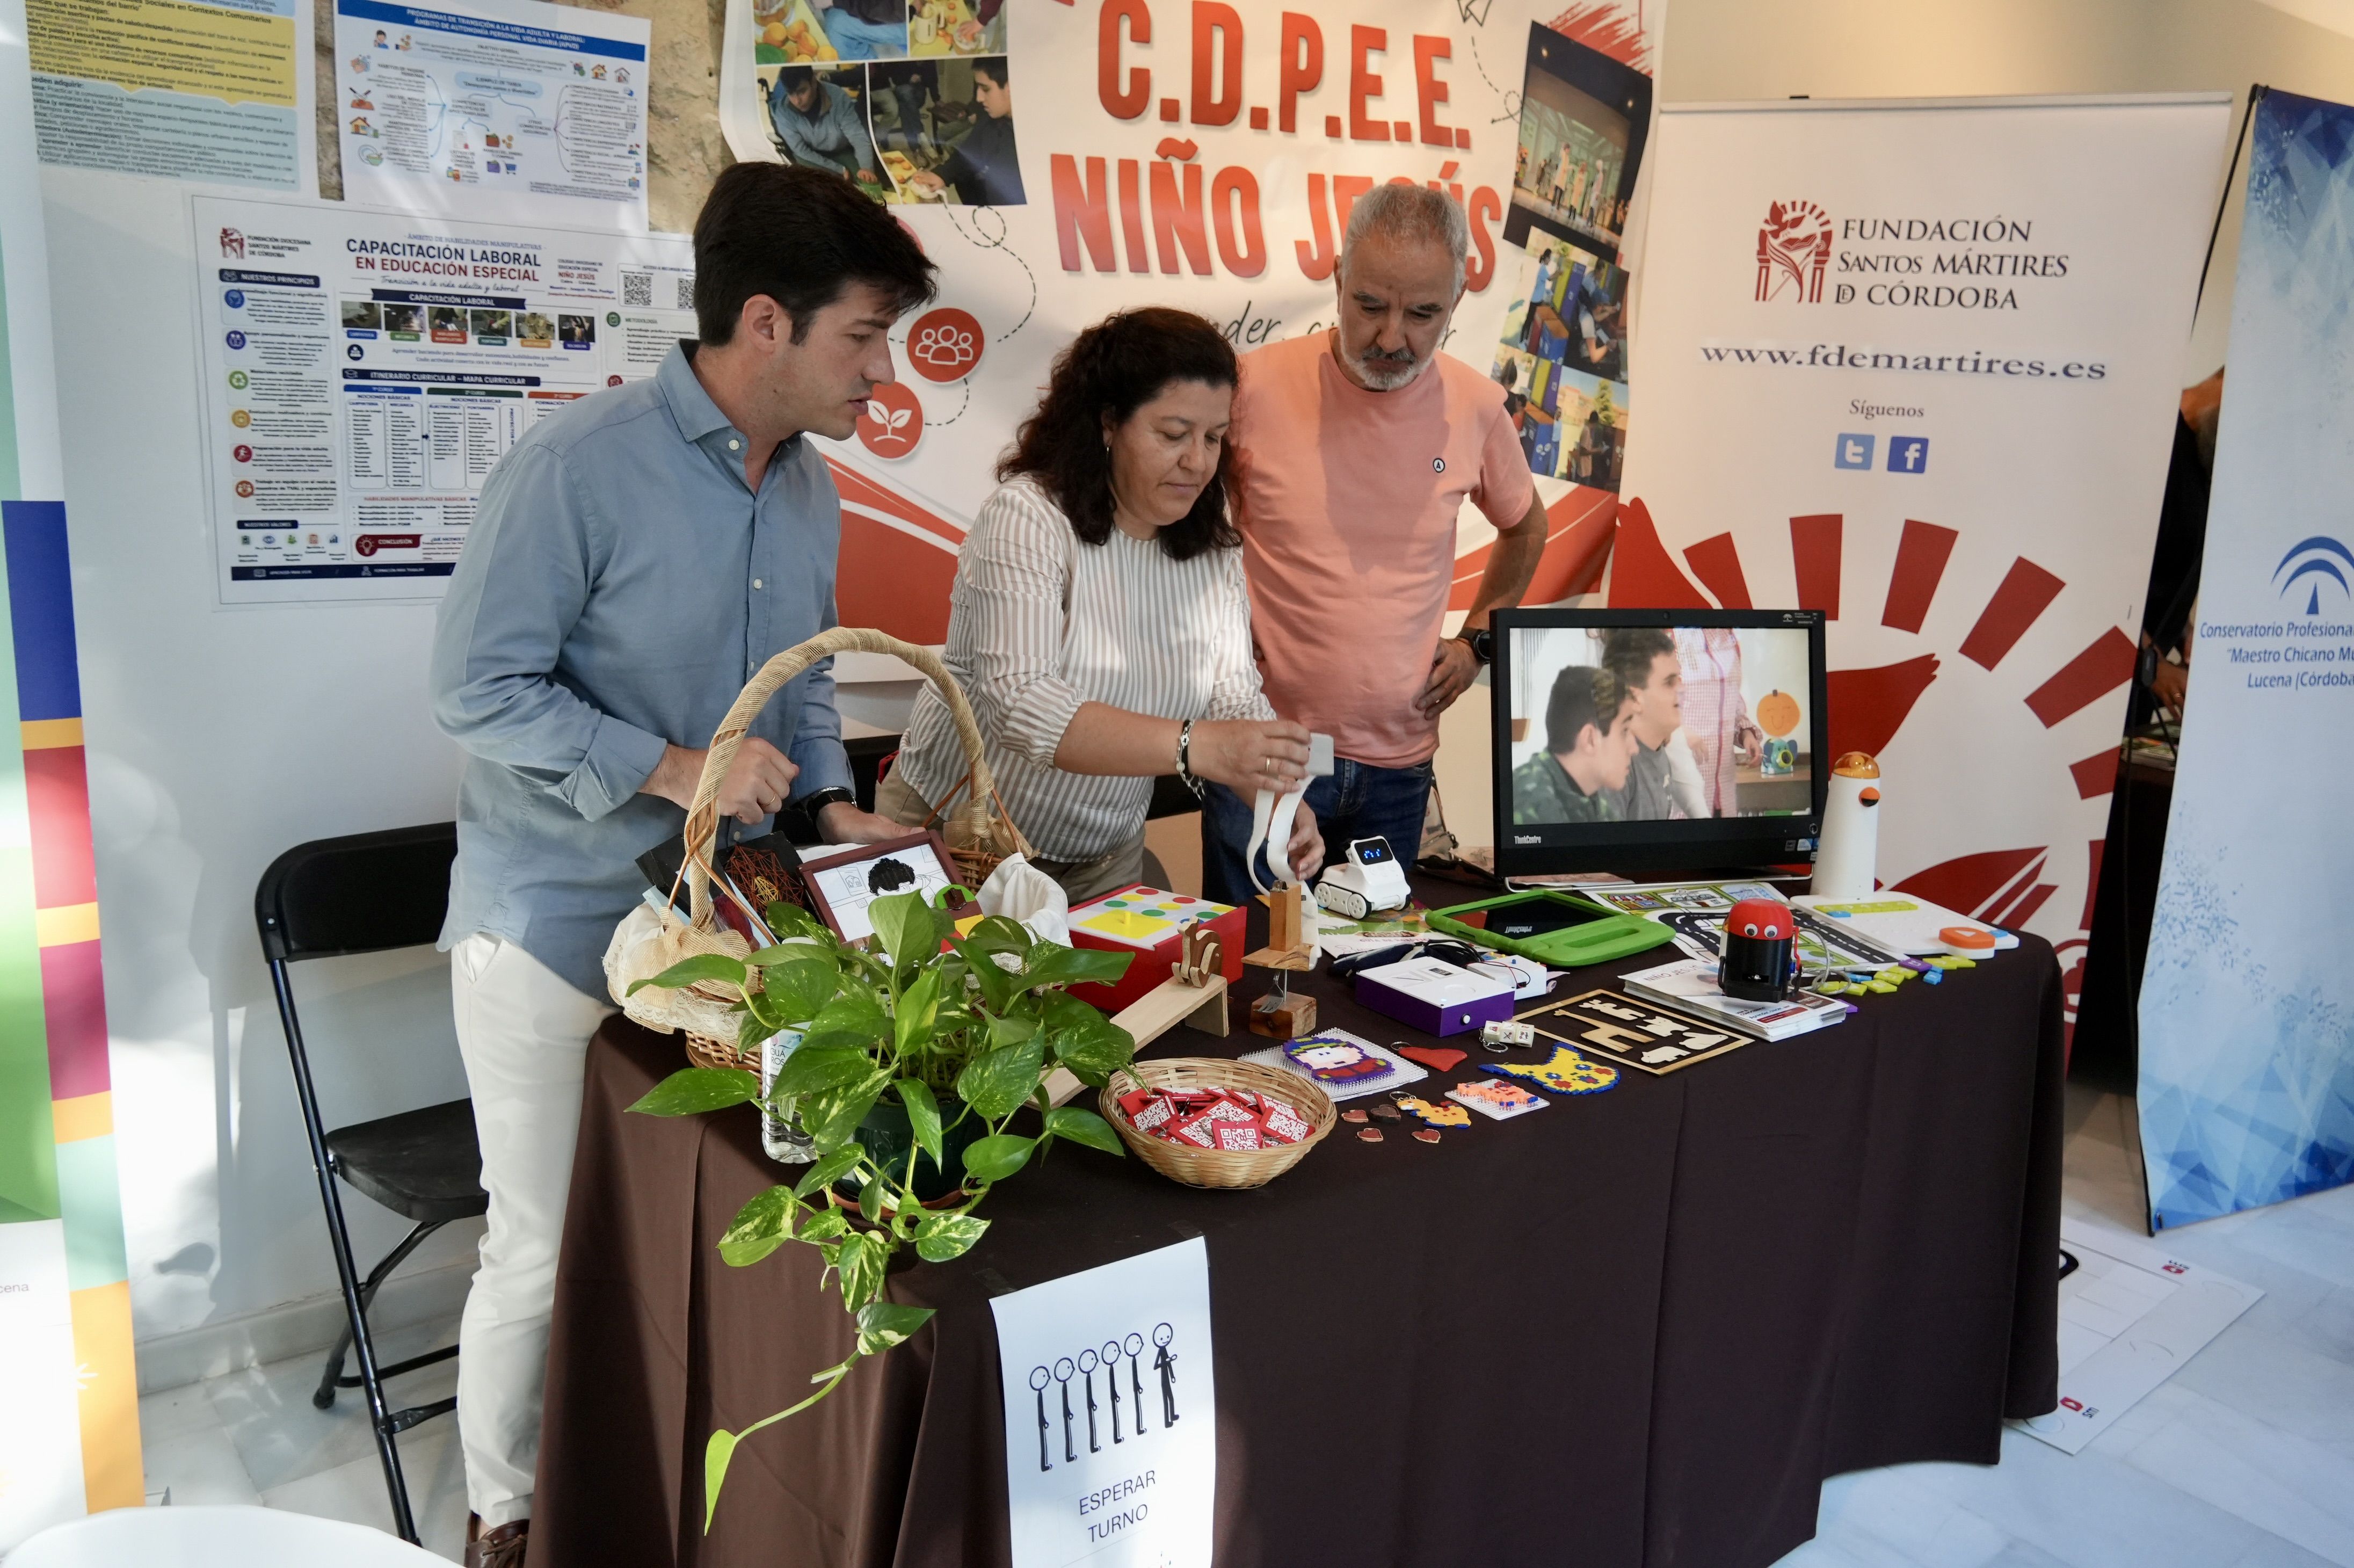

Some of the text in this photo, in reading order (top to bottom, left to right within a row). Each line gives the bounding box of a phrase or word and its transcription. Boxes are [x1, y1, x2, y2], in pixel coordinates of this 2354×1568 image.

[188, 5, 224, 16] Contextos
[226, 11, 271, 24] Comunitarios
[1099, 0, 1470, 149] C.D.P.E.E.
[1050, 137, 1267, 279] NIÑO
[1842, 215, 2032, 244] FUNDACIÓN
[347, 239, 464, 261] CAPACITACIÓN
[471, 249, 541, 266] LABORAL
[1932, 248, 2070, 278] MÁRTIRES
[356, 257, 540, 281] EN EDUCACIÓN ESPECIAL
[1867, 280, 2020, 310] CÓRDOBA
[1701, 344, 2106, 381] www.fdemartires.es
[1849, 398, 1925, 420] Síguenos
[2200, 622, 2283, 638] Conservatorio
[2284, 647, 2335, 662] Chicano
[2247, 672, 2292, 688] Lucena
[1079, 1470, 1156, 1516] ESPERAR
[1088, 1504, 1148, 1543] TURNO
